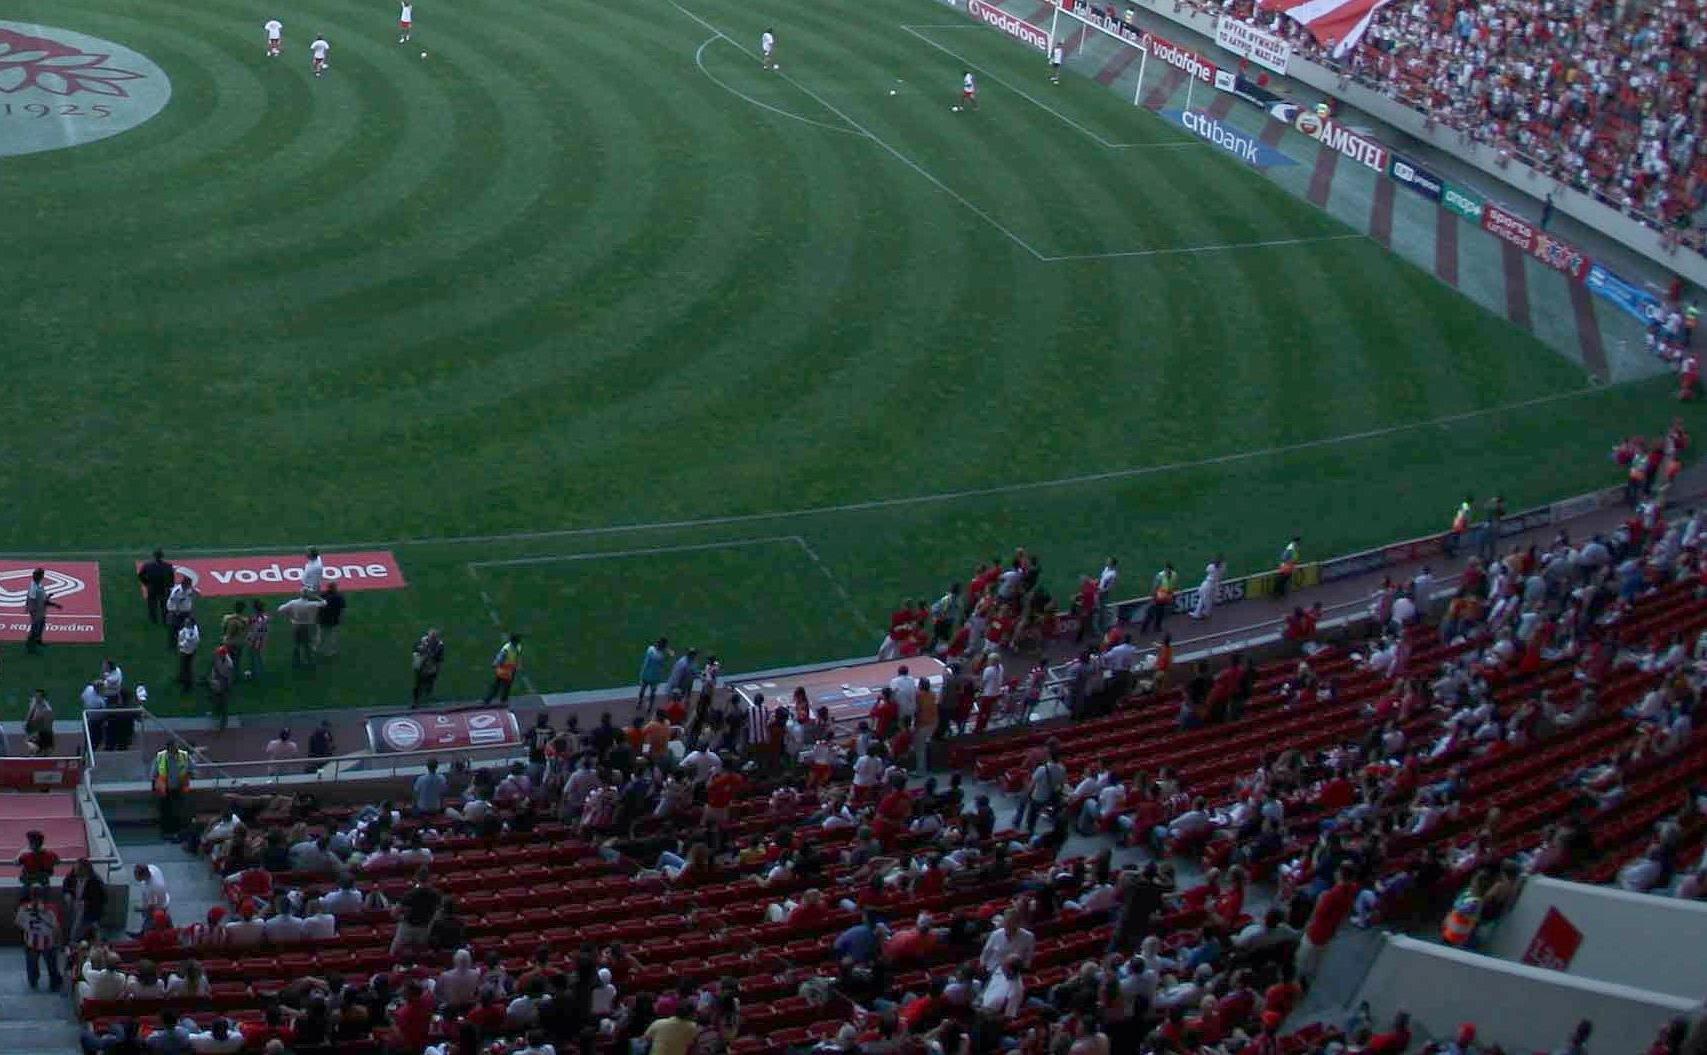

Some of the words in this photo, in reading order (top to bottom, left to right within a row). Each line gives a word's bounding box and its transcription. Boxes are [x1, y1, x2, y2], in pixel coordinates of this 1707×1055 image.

[980, 7, 1047, 51] vodafone
[1152, 38, 1210, 82] vodafone
[3, 102, 113, 119] 1925
[1182, 110, 1259, 164] citibank
[1320, 120, 1383, 172] AMSTEL
[1490, 209, 1532, 237] sports
[210, 562, 388, 585] vodaone
